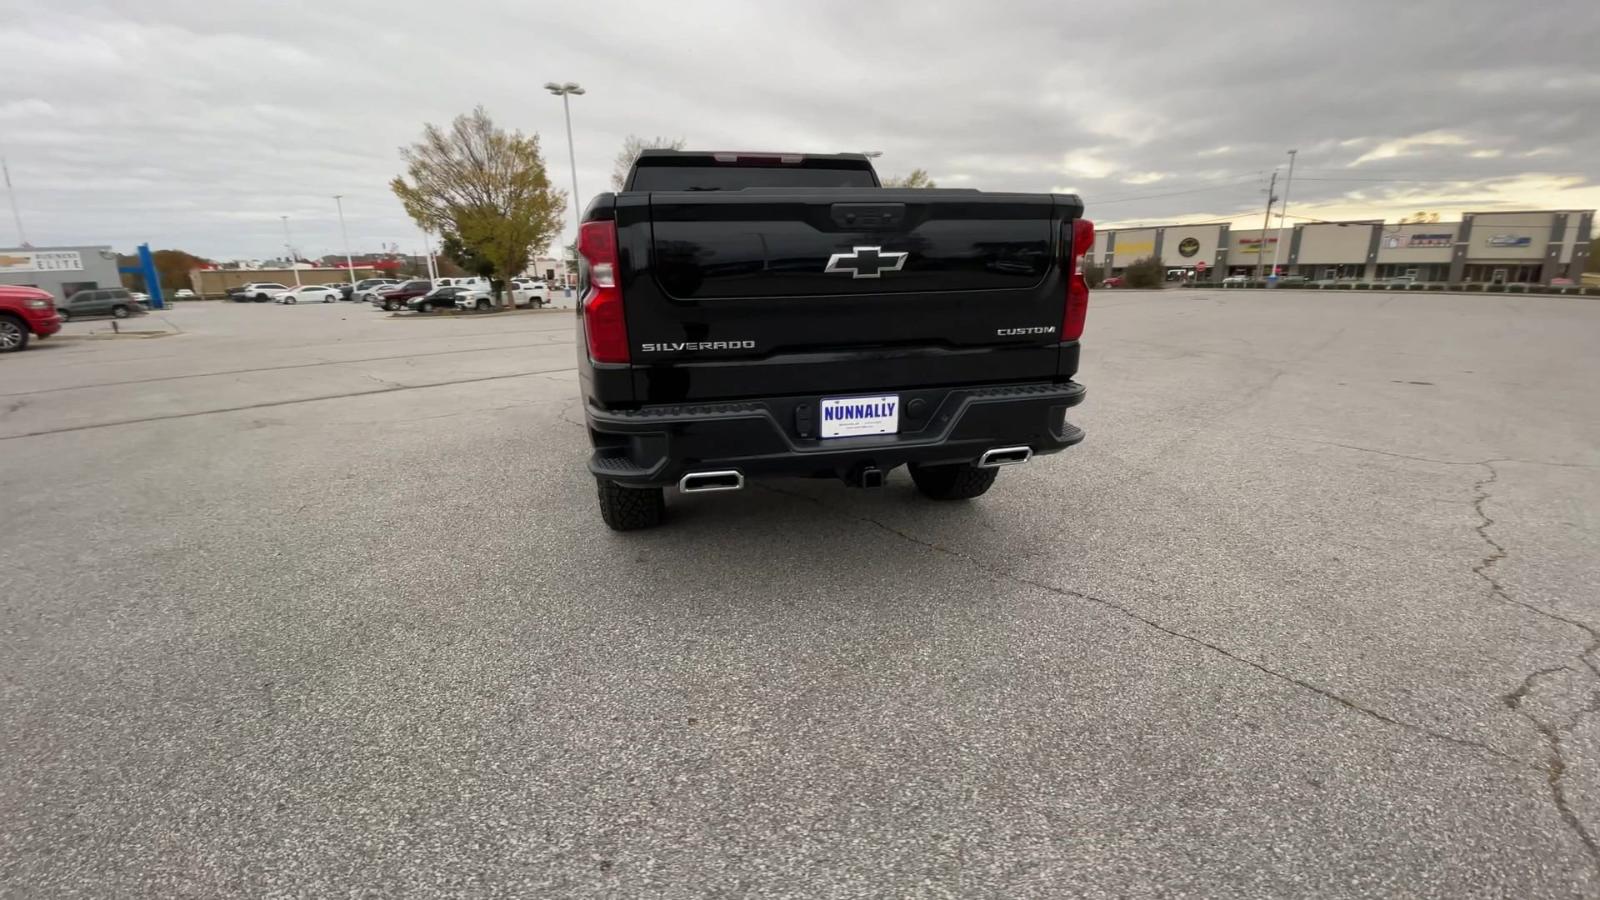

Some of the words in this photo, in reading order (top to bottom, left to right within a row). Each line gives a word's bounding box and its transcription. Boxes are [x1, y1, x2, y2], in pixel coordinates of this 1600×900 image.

[37, 260, 81, 270] ELITE
[997, 326, 1056, 336] CUSTOM
[641, 340, 755, 352] SILVERADO
[824, 402, 895, 421] NUNNALLY
